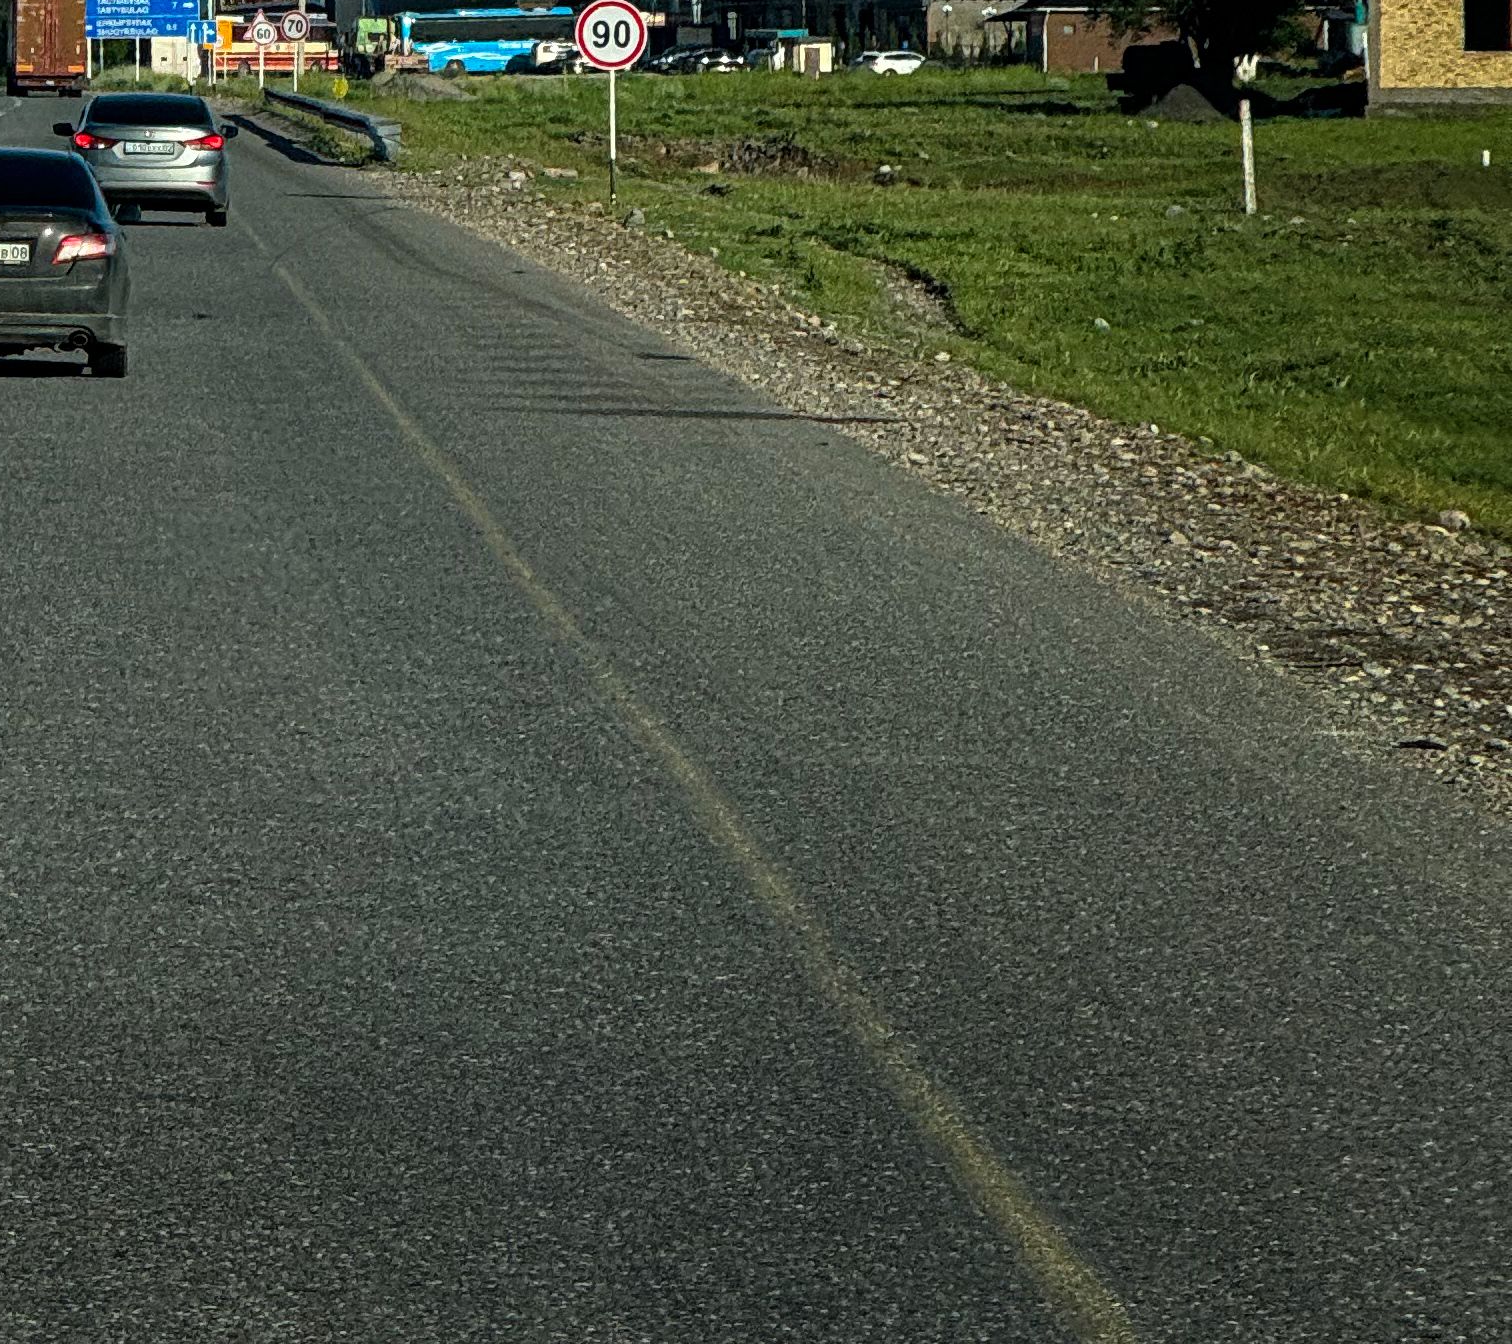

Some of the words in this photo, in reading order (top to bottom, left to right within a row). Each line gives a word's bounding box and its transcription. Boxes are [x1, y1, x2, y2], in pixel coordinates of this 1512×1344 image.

[287, 19, 303, 33] 70
[256, 28, 271, 39] 60
[592, 20, 629, 49] 90
